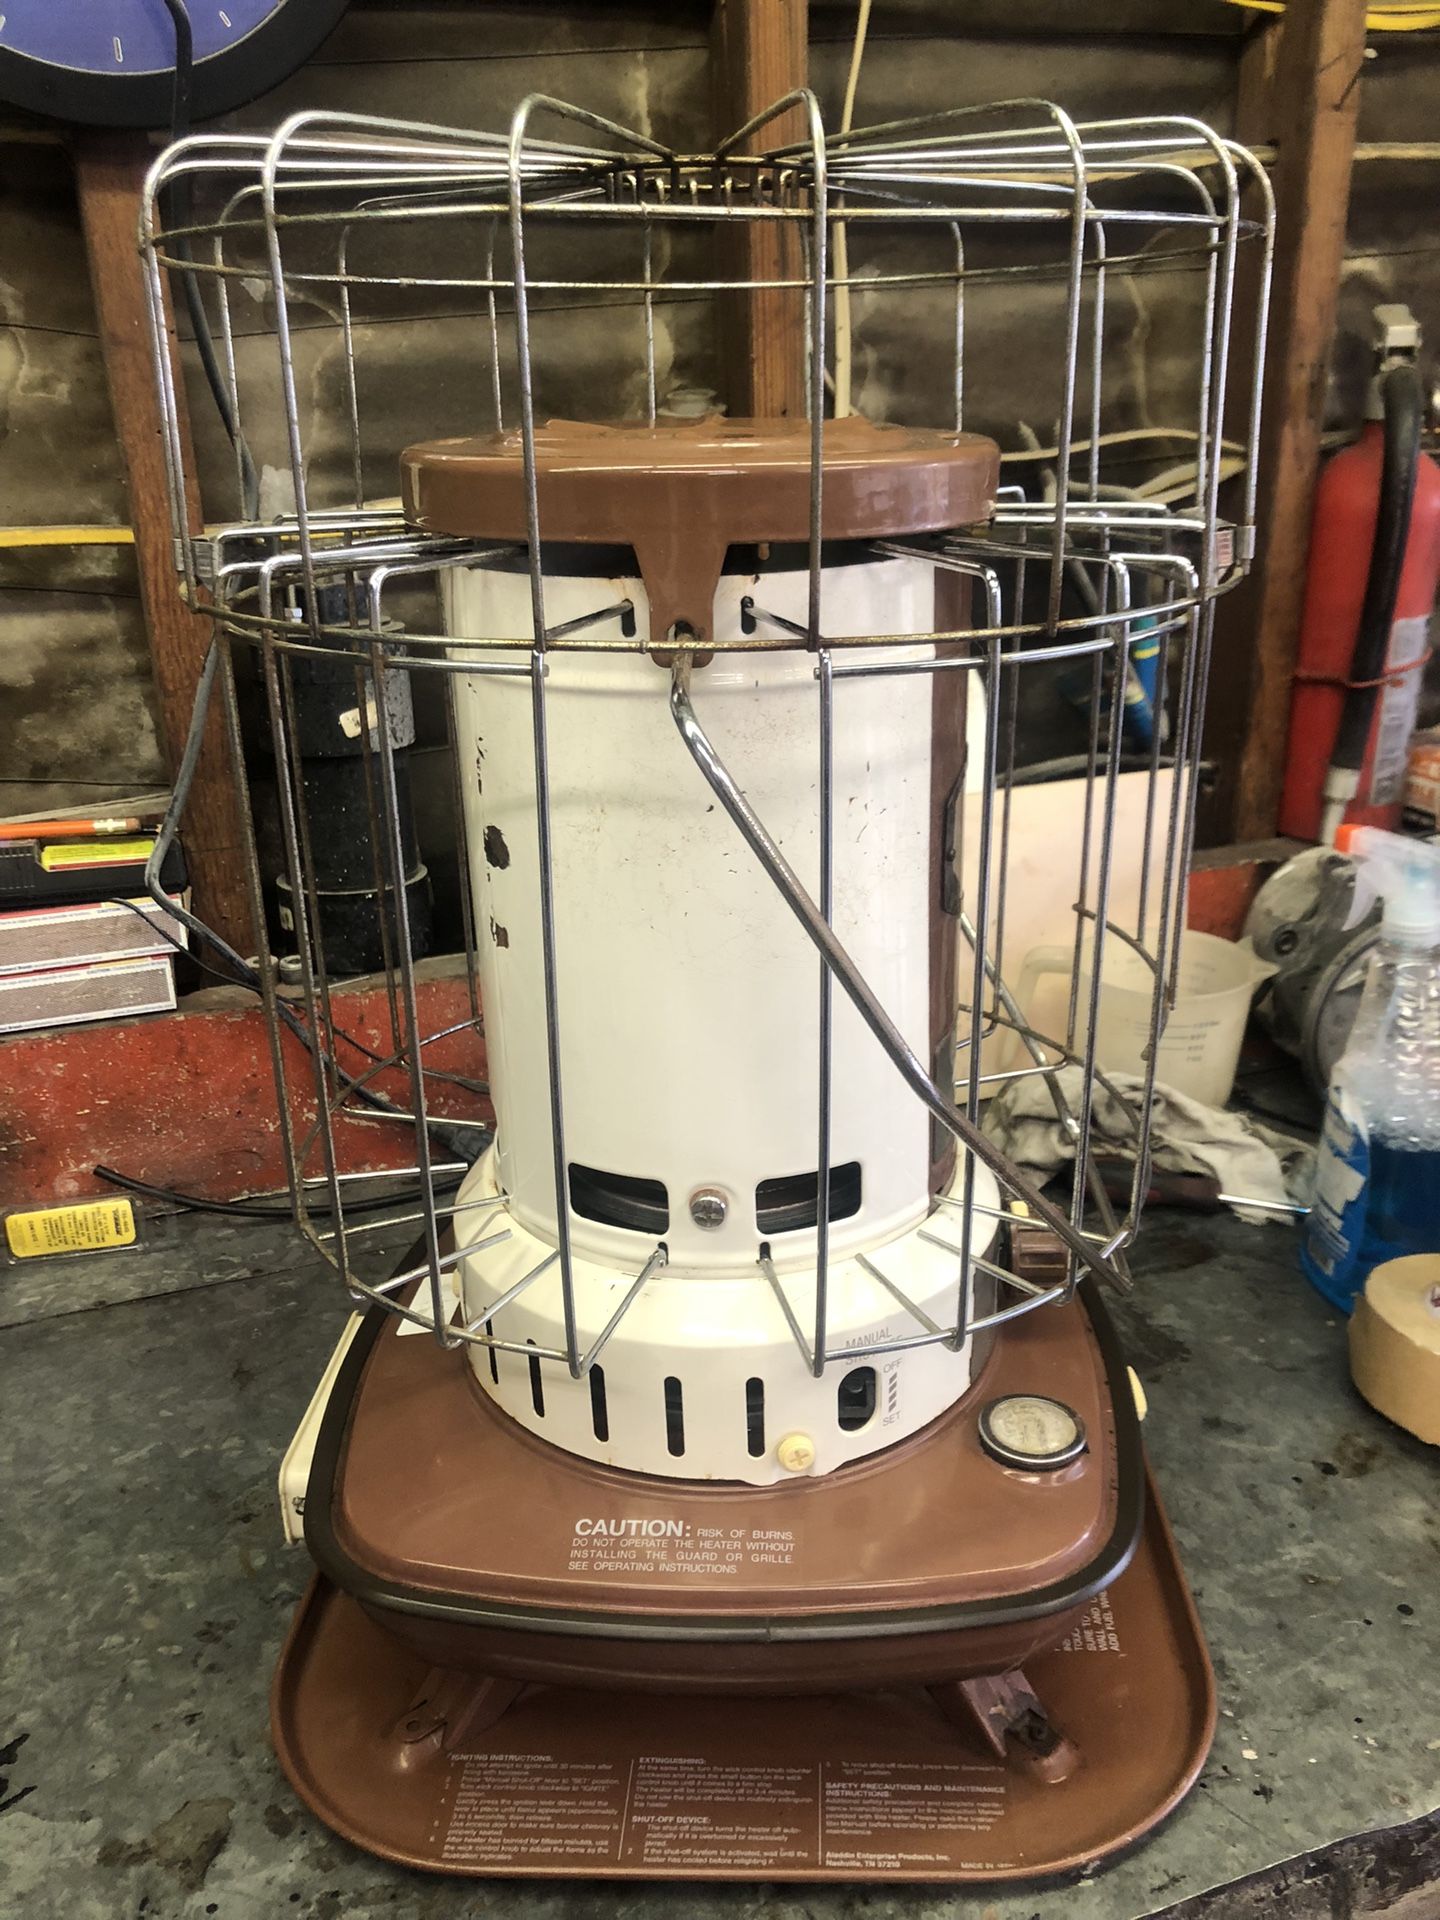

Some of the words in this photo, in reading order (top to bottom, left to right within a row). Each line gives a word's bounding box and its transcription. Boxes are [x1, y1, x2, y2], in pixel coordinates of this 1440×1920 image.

[845, 1326, 892, 1348] MANUAL
[883, 1357, 903, 1373] OFF
[882, 1410, 901, 1426] SET
[575, 1518, 691, 1537] CAUTION:
[697, 1528, 722, 1537] RISK
[730, 1529, 746, 1538] OF
[572, 1538, 588, 1547] DO
[593, 1538, 615, 1547] NOT
[620, 1538, 668, 1548] OPERATE
[674, 1539, 694, 1549] THE
[699, 1540, 741, 1550] HEATER
[746, 1541, 795, 1552] WITHOUT
[570, 1549, 637, 1559] INSTALLING
[647, 1550, 667, 1560] THE
[676, 1551, 717, 1561] GUARD
[726, 1552, 743, 1562] OR
[751, 1553, 795, 1564] GRILLE.
[568, 1561, 588, 1571] SEE
[594, 1561, 655, 1572] OPERATING
[1103, 1611, 1115, 1630] FUEL
[1107, 1633, 1120, 1651] ADD
[861, 1783, 921, 1791] PRECAUTIONS
[631, 1815, 675, 1823] SHUT-OFF
